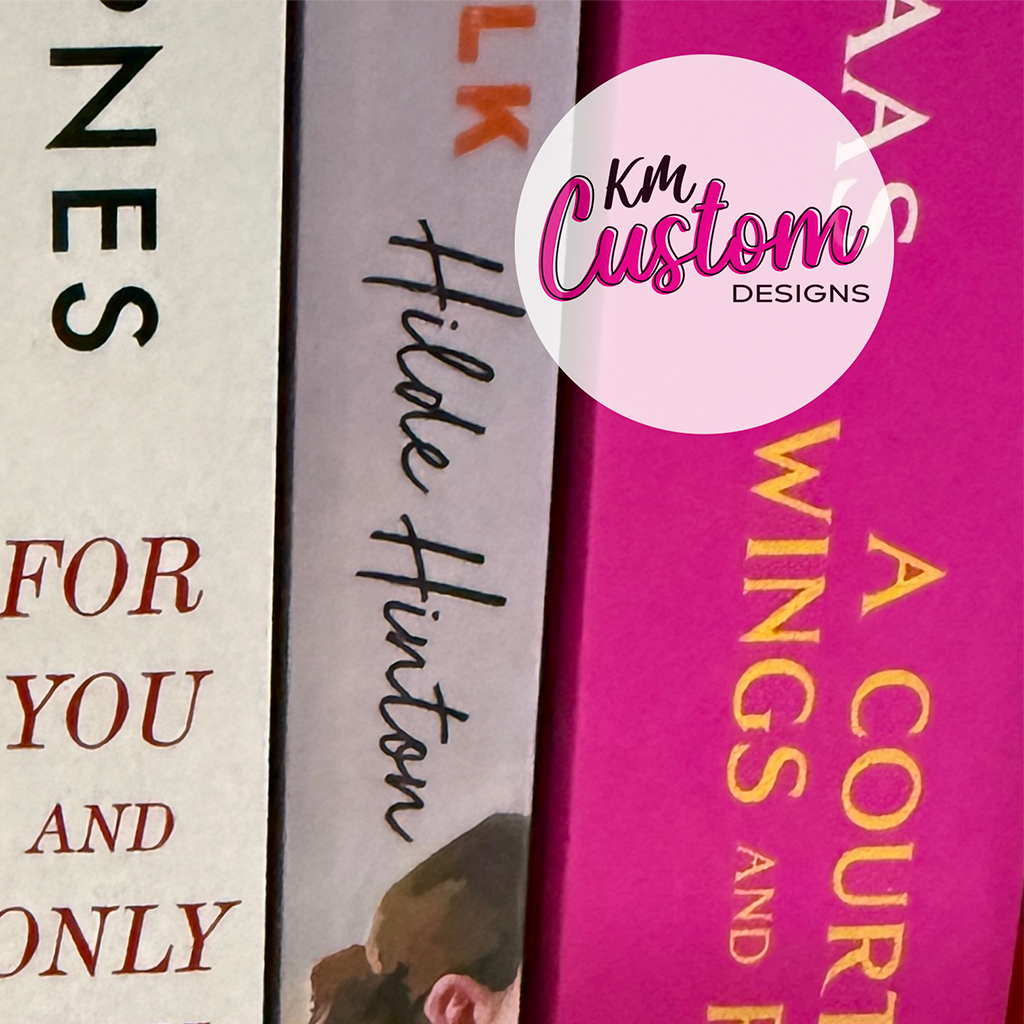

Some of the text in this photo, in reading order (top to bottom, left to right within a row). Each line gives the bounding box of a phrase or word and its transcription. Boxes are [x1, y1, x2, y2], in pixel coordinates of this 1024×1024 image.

[453, 4, 536, 158] LK
[45, 0, 164, 351] NES
[356, 219, 526, 842] Hilde Hinton
[860, 532, 947, 618] A
[725, 418, 842, 805] WINGS
[5, 669, 214, 751] YOU
[24, 803, 175, 855] AND
[728, 844, 776, 966] AND
